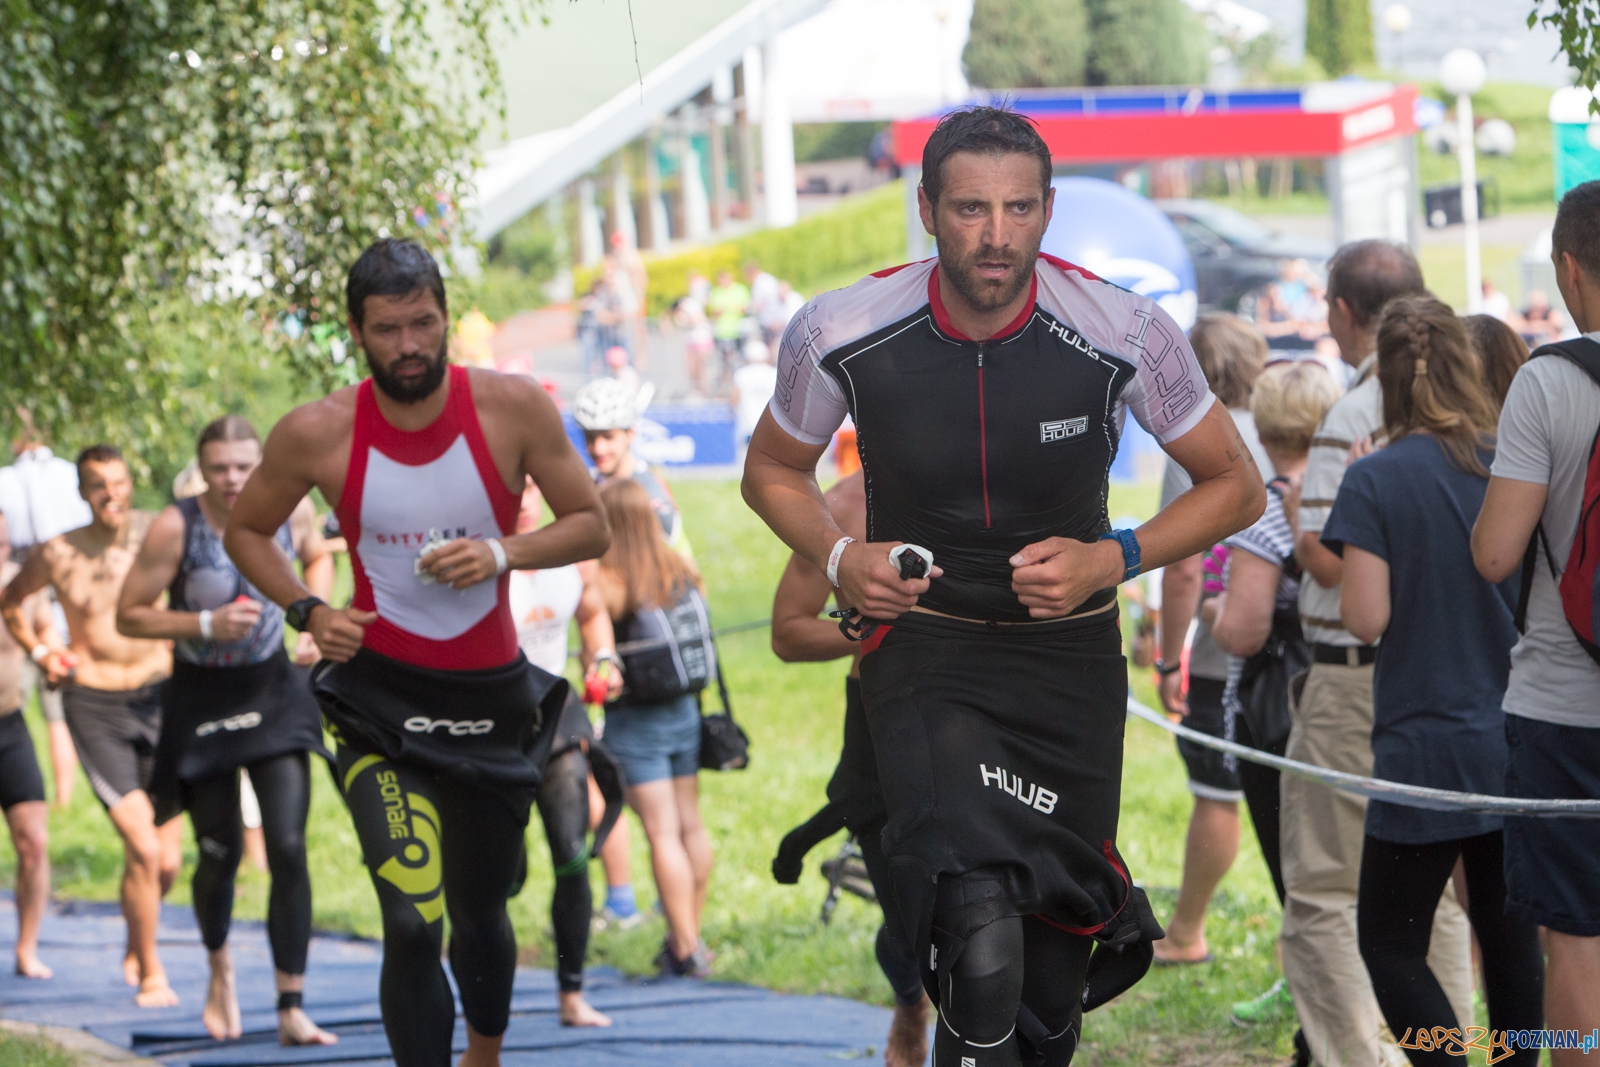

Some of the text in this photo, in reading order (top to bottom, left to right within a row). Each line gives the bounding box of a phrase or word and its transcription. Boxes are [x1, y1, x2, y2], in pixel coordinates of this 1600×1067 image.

[1048, 320, 1100, 361] HUUB
[1042, 425, 1087, 442] HUUB
[375, 526, 467, 546] CITYEN
[403, 716, 495, 736] orca
[979, 763, 1058, 815] HUUB
